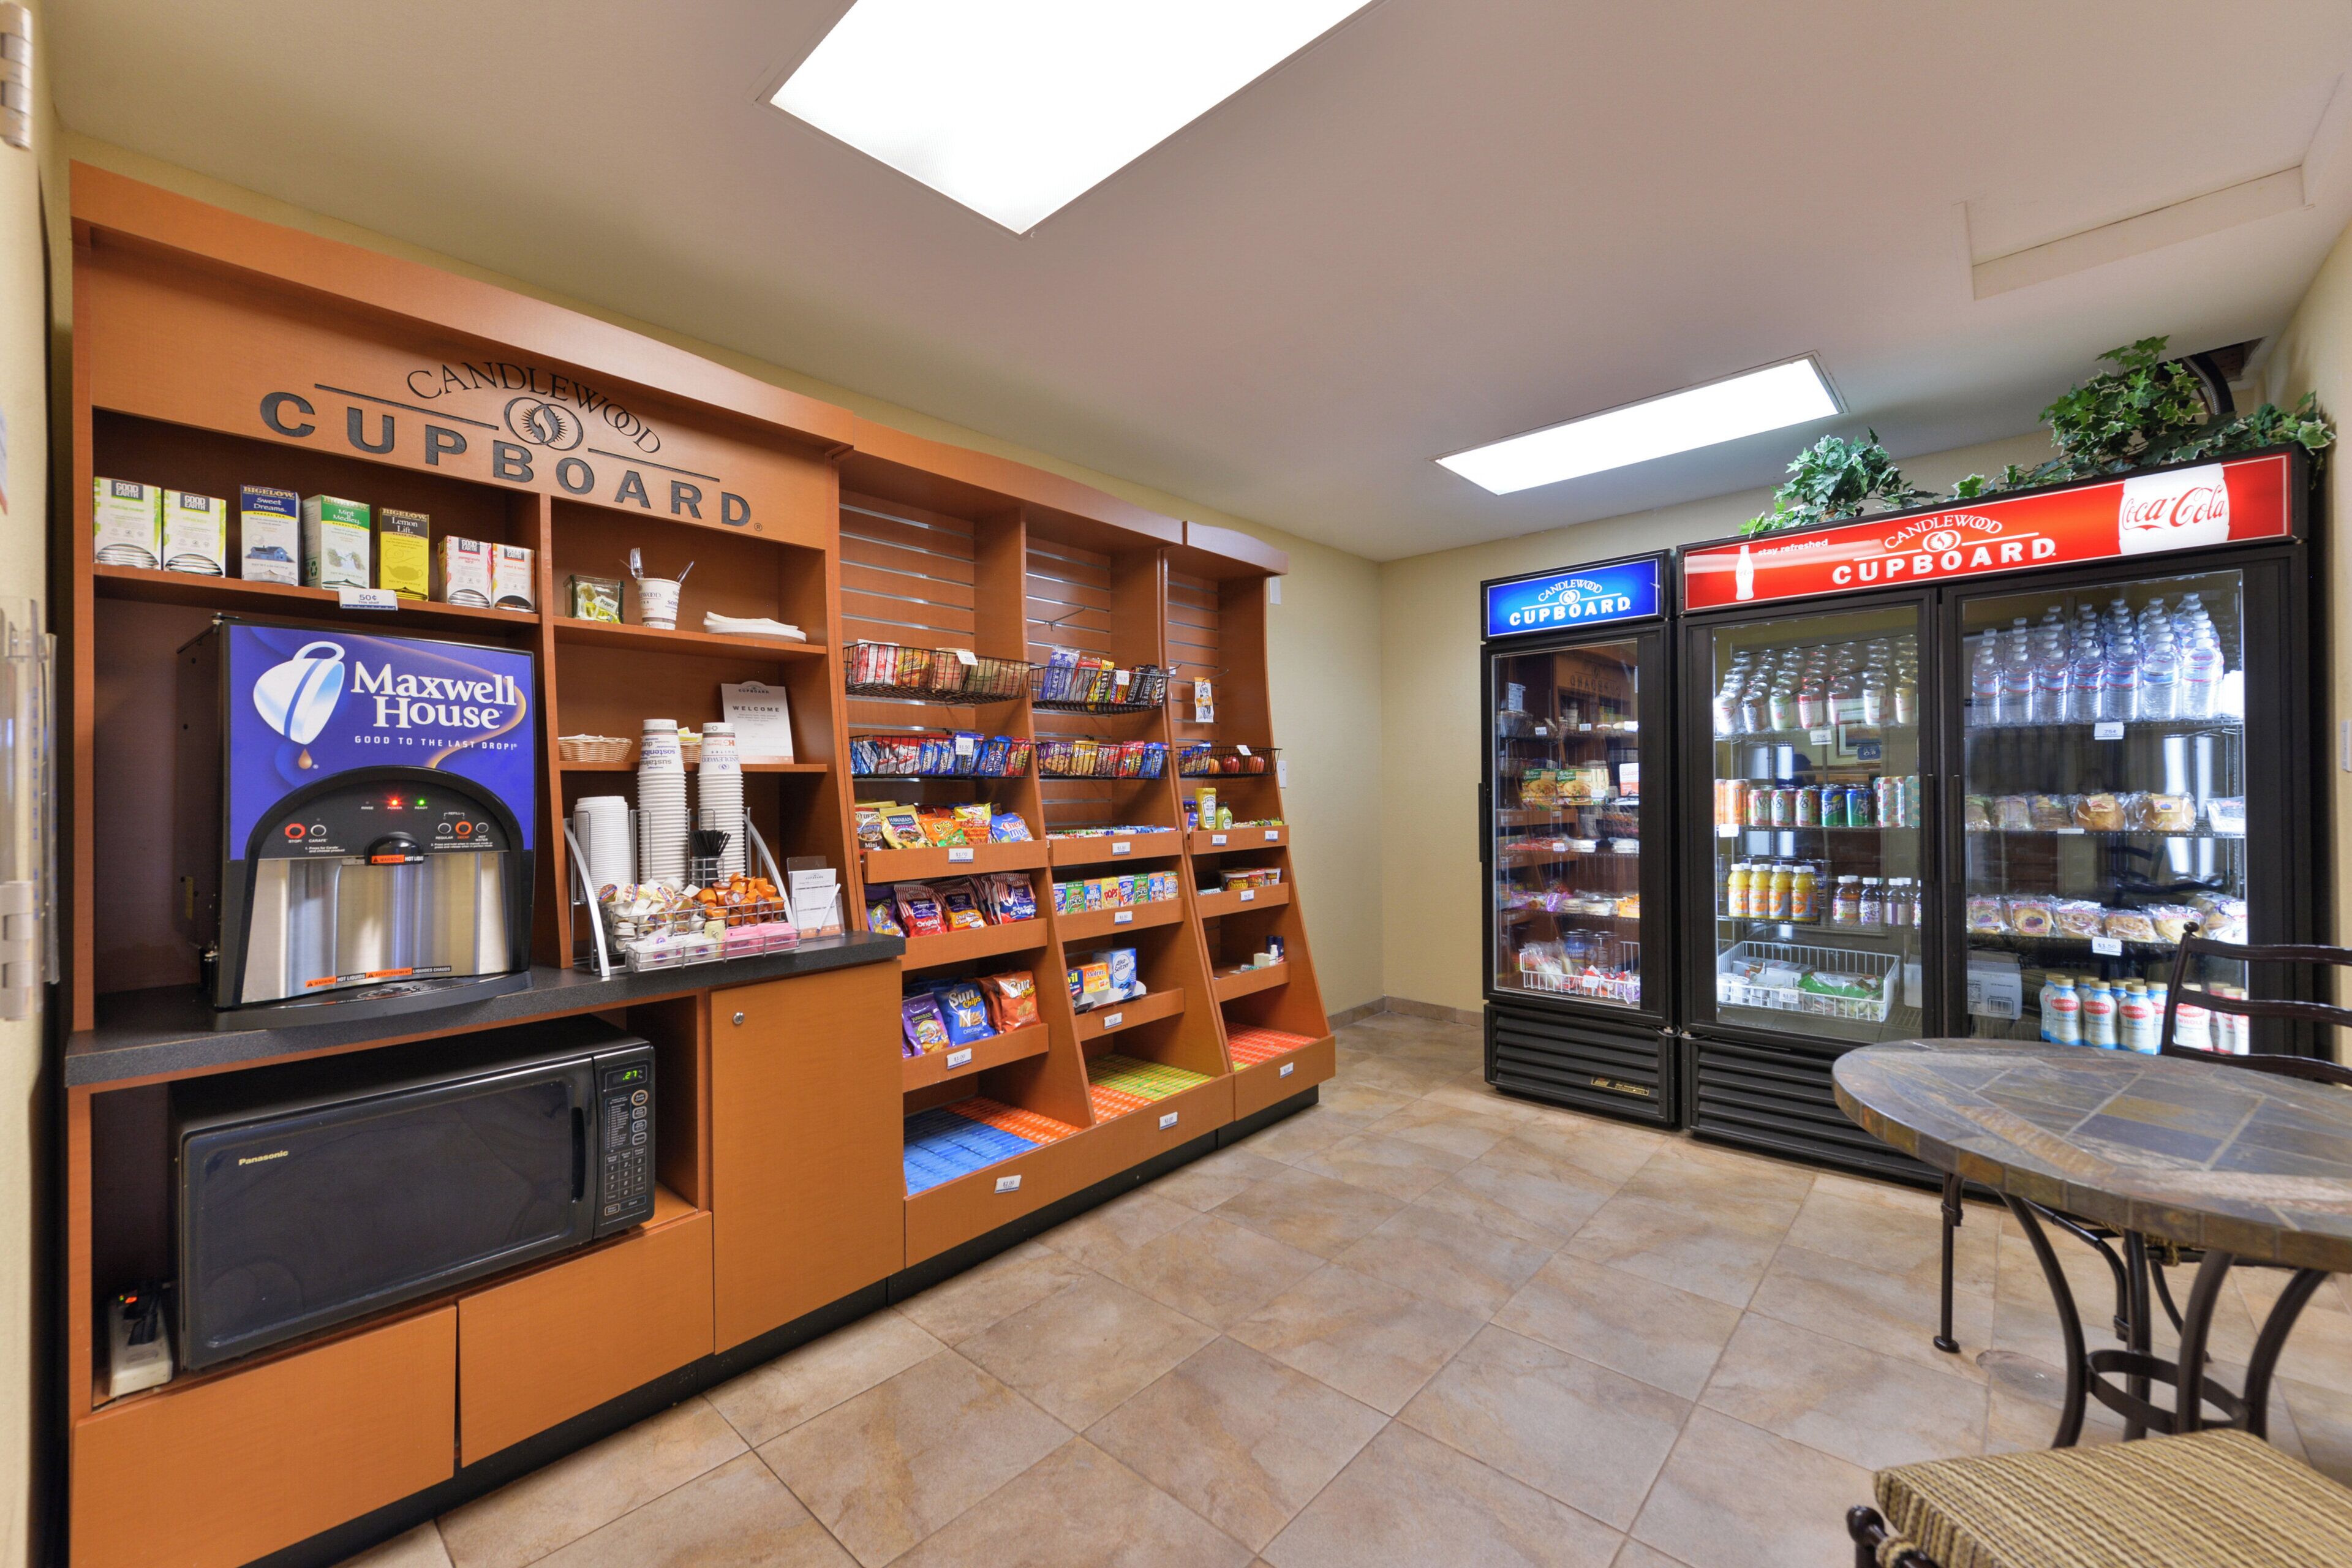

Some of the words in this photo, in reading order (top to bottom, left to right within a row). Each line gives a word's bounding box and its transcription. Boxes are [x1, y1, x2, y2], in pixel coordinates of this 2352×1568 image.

[407, 361, 662, 454] CANDLEWOOD
[260, 391, 751, 527] CUPBOARD
[116, 483, 139, 492] GOOD
[243, 486, 294, 498] BIGELOW
[184, 496, 206, 505] GOOD
[2122, 484, 2225, 530] Coca-Cola
[254, 503, 286, 512] Dreams
[383, 508, 428, 520] BIGELOW
[333, 514, 360, 525] Medley
[392, 517, 418, 527] Lemon
[1885, 515, 2002, 549] CANDLEWOOD
[1781, 539, 1828, 553] refreshed
[1833, 538, 2054, 584] CUPBOARD
[1538, 579, 1602, 602] CANDLEWOOD
[1509, 597, 1629, 626] CUPBOARD
[350, 662, 517, 706] Maxwell
[373, 696, 500, 729] House
[481, 741, 513, 750] DROP!
[1002, 820, 1022, 831] Chex
[916, 918, 940, 927] Original
[1115, 963, 1129, 973] Seltzer
[949, 989, 974, 1006] Sun
[963, 996, 981, 1008] Chips
[238, 1150, 289, 1166] Panasonic
